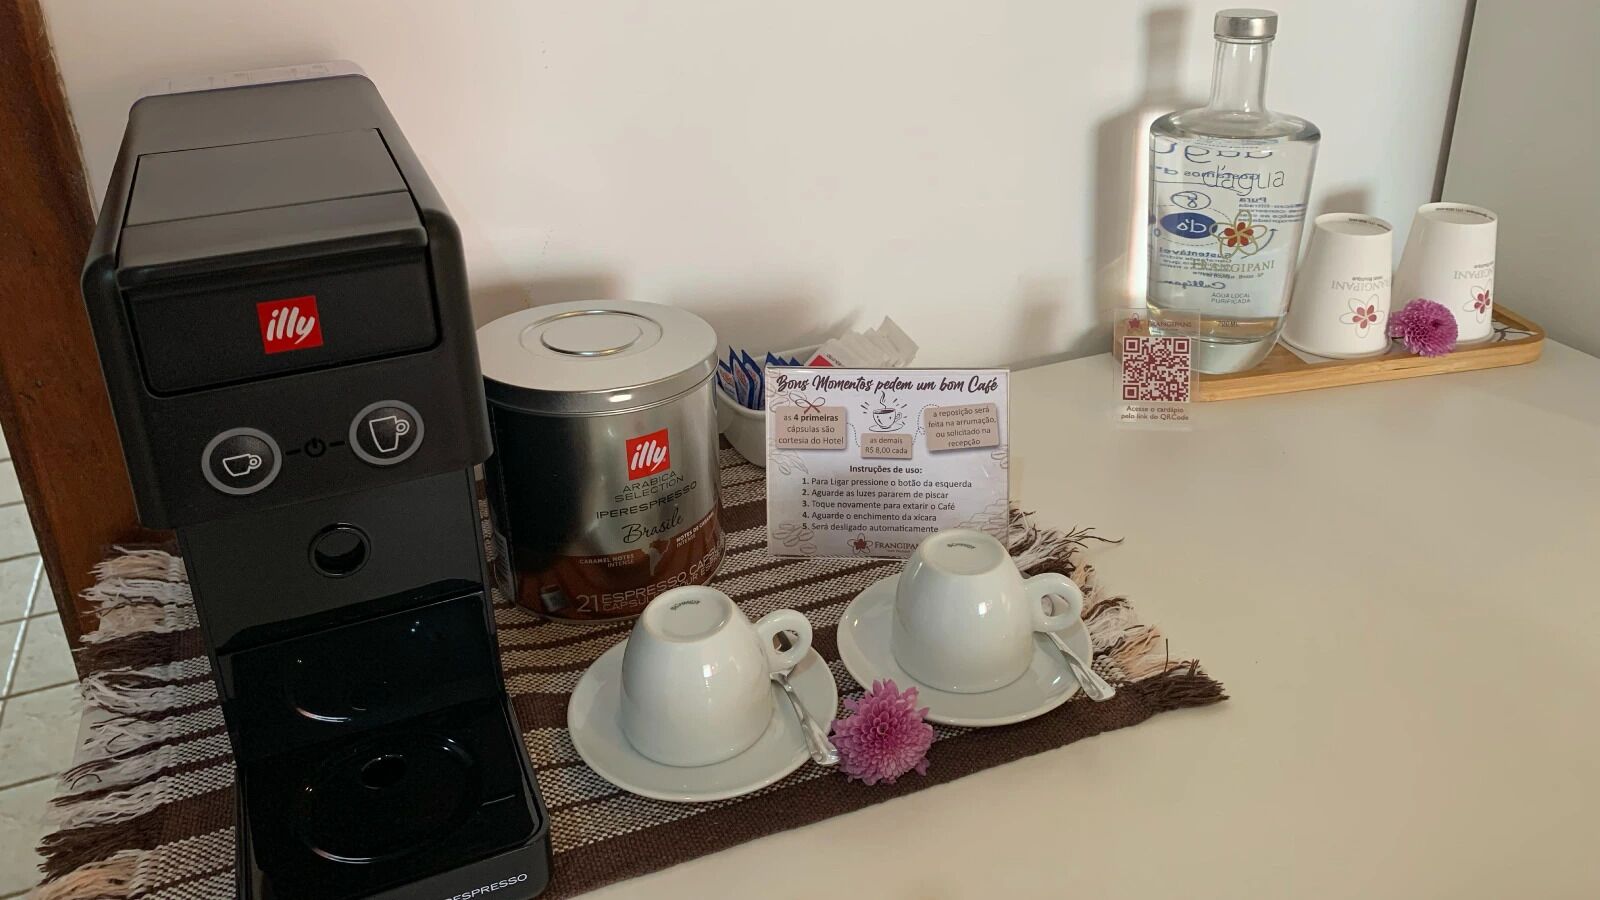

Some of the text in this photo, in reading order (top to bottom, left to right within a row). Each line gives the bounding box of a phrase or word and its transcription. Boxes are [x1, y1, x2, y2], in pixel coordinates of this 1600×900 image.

[266, 306, 316, 345] illy
[776, 374, 999, 394] Bons Momentos pedem um bom Café
[939, 407, 973, 418] reposição
[974, 404, 990, 415] será
[800, 413, 839, 423] primeiras
[956, 416, 997, 426] arrumação,
[786, 425, 836, 434] cápsulas são
[946, 427, 981, 437] solicitado
[778, 437, 844, 445] cortesia do Hotel
[878, 436, 903, 444] demais
[948, 438, 981, 448] recepção
[630, 439, 668, 472] illy
[875, 446, 891, 454] 8,00
[891, 447, 908, 455] cada
[849, 465, 891, 474] Instruções
[892, 466, 903, 474] de
[622, 470, 677, 493] ARABICA
[801, 477, 810, 485] 1.
[811, 478, 829, 486] Para
[830, 478, 850, 487] Ligar
[850, 478, 889, 487] pressione
[897, 479, 922, 487] botão
[923, 479, 933, 487] da
[935, 480, 972, 489] esquerda
[614, 475, 684, 503] SELECTION
[801, 488, 810, 496] 2.
[811, 489, 845, 498] Aguarde
[856, 489, 876, 497] luzes
[877, 491, 911, 499] pararem
[925, 491, 949, 500] piscar
[596, 481, 697, 519] IPERESPRESSO
[801, 500, 810, 508] 3.
[811, 500, 836, 509] Toque
[837, 501, 881, 509] novamente
[902, 502, 929, 510] extarir
[937, 502, 956, 511] Café
[801, 511, 810, 519] 4.
[811, 511, 845, 520] Aguarde
[853, 512, 900, 520] enchimento
[901, 513, 912, 521] da
[621, 506, 684, 544] Brasile
[801, 522, 939, 533] 5. Será desligado automaticamente
[580, 552, 635, 565] CARAMEL NOTES
[607, 559, 634, 568] INTENSE
[576, 594, 599, 613] 21
[601, 571, 687, 605] ESPRESSO
